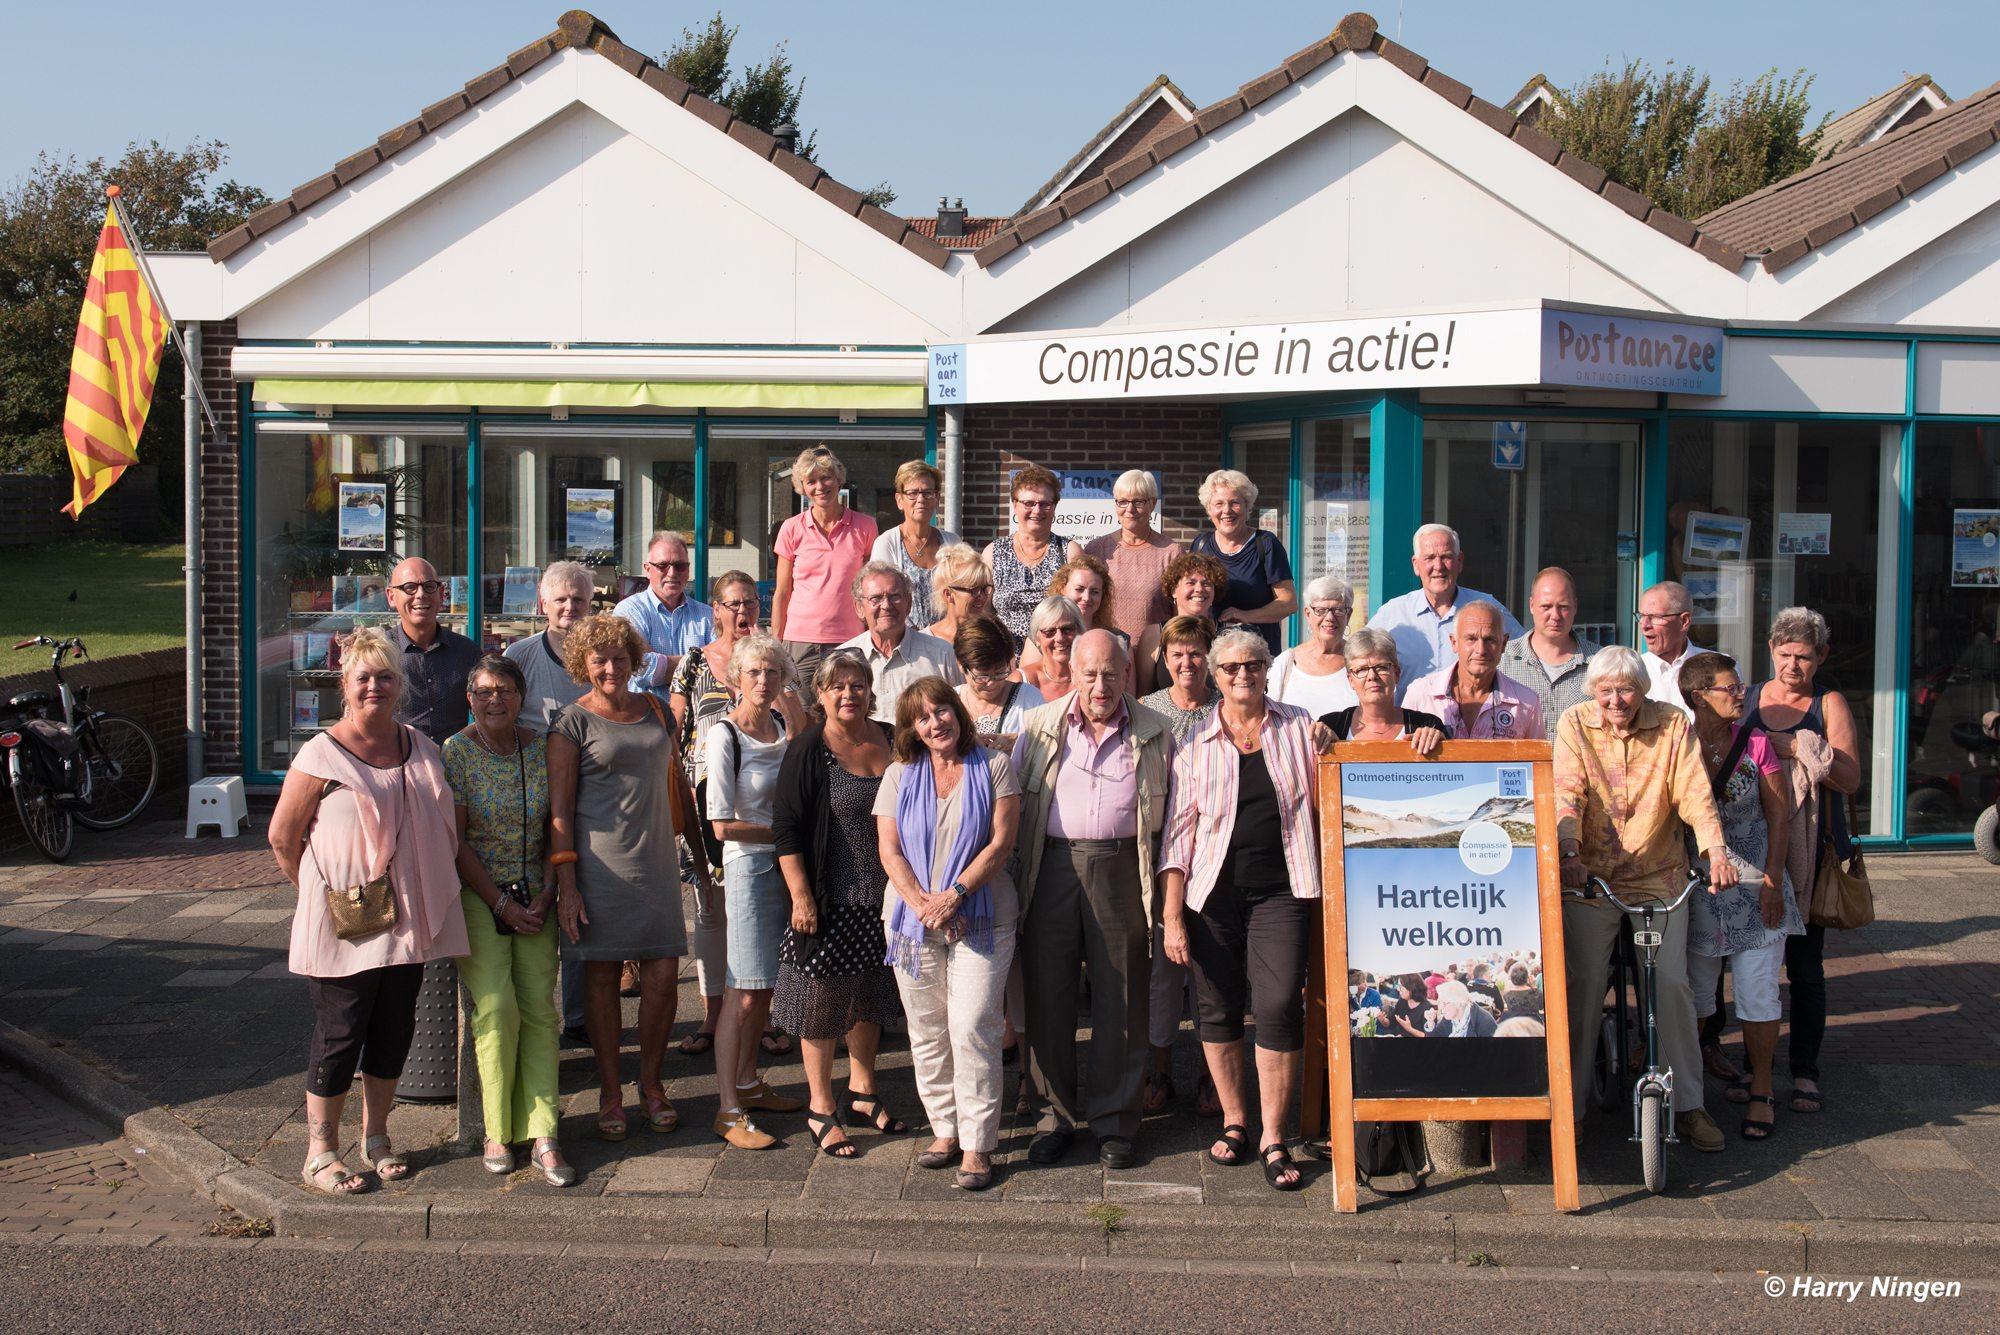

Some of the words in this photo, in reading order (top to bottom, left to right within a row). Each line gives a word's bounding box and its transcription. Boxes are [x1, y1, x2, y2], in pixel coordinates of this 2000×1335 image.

[935, 351, 959, 366] Post
[1038, 330, 1259, 392] Compassie
[1274, 326, 1311, 375] in
[1327, 320, 1456, 373] actie!
[937, 369, 958, 380] aan
[1576, 370, 1702, 389] ONTMOETINGSCENTRUM
[938, 384, 957, 398] Zee
[1100, 511, 1113, 525] in
[1347, 772, 1464, 784] Ontmoetingscentrum
[1502, 769, 1522, 778] Post
[1505, 787, 1521, 796] Zee
[1462, 841, 1508, 851] Compassie
[1479, 851, 1501, 859] actie!
[1377, 883, 1507, 915] Hartelijk
[1381, 921, 1503, 947] welkom
